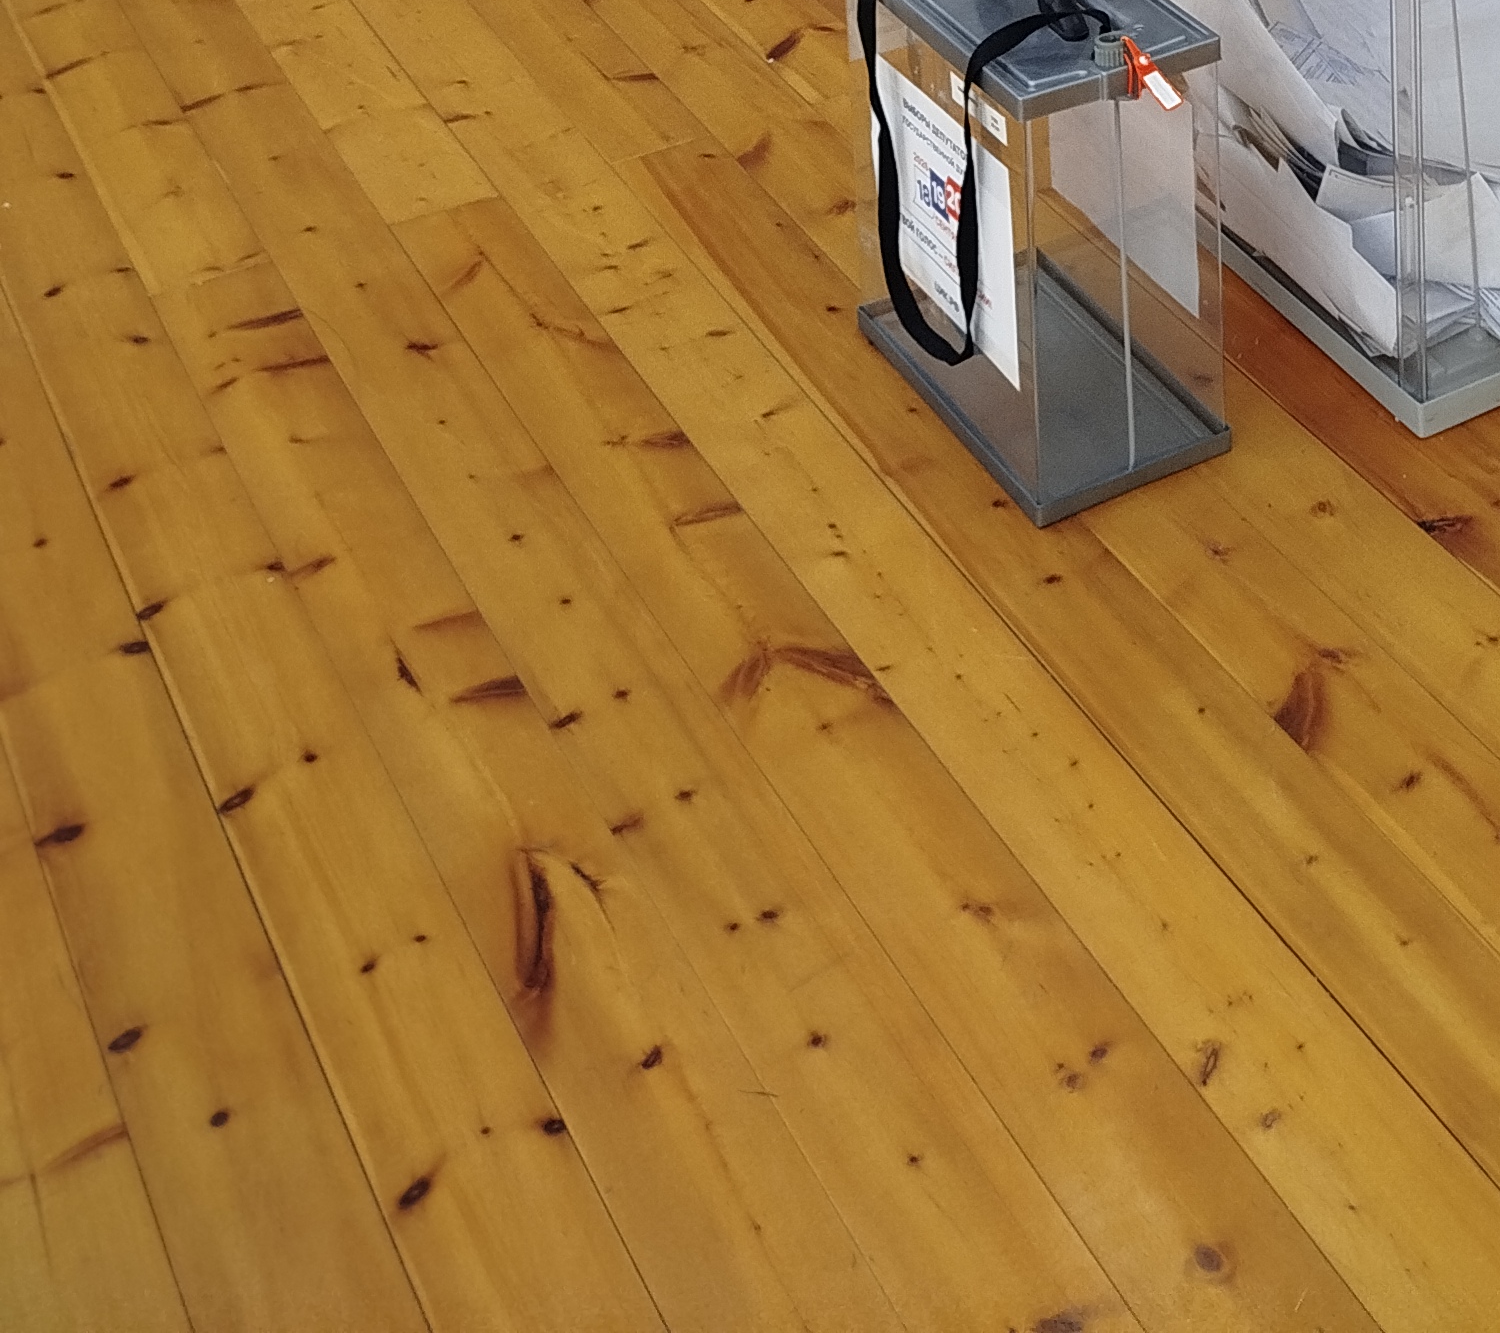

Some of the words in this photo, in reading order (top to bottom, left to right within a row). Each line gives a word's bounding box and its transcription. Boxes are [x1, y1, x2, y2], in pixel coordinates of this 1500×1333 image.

[931, 123, 966, 161] ДЕПУТАТО
[917, 179, 931, 208] 18
[932, 181, 945, 210] 19
